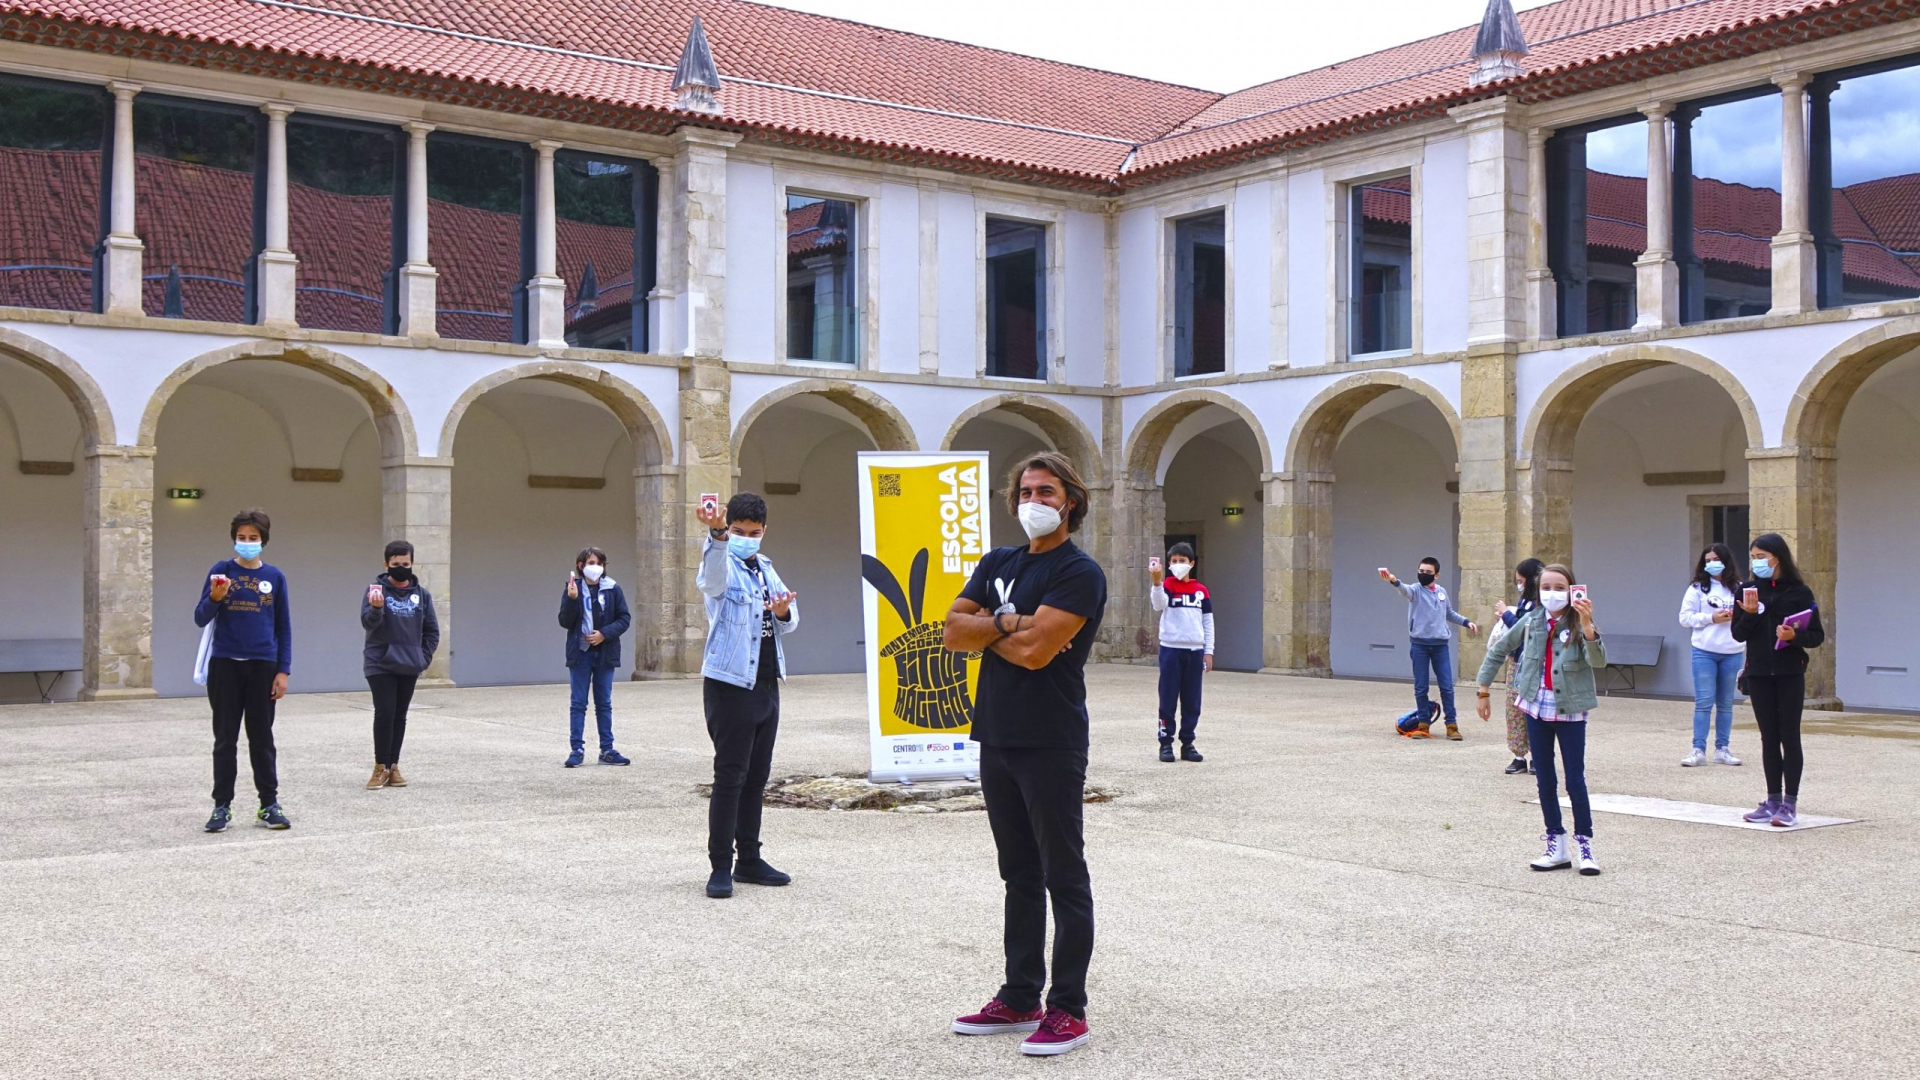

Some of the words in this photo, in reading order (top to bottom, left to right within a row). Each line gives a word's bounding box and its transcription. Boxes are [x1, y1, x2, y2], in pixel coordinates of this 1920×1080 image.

[938, 466, 961, 573] ESCOLA
[959, 466, 981, 554] MAGIA
[963, 561, 979, 587] E
[1172, 594, 1202, 607] FILA
[880, 621, 946, 657] MONTEMOR-O-V
